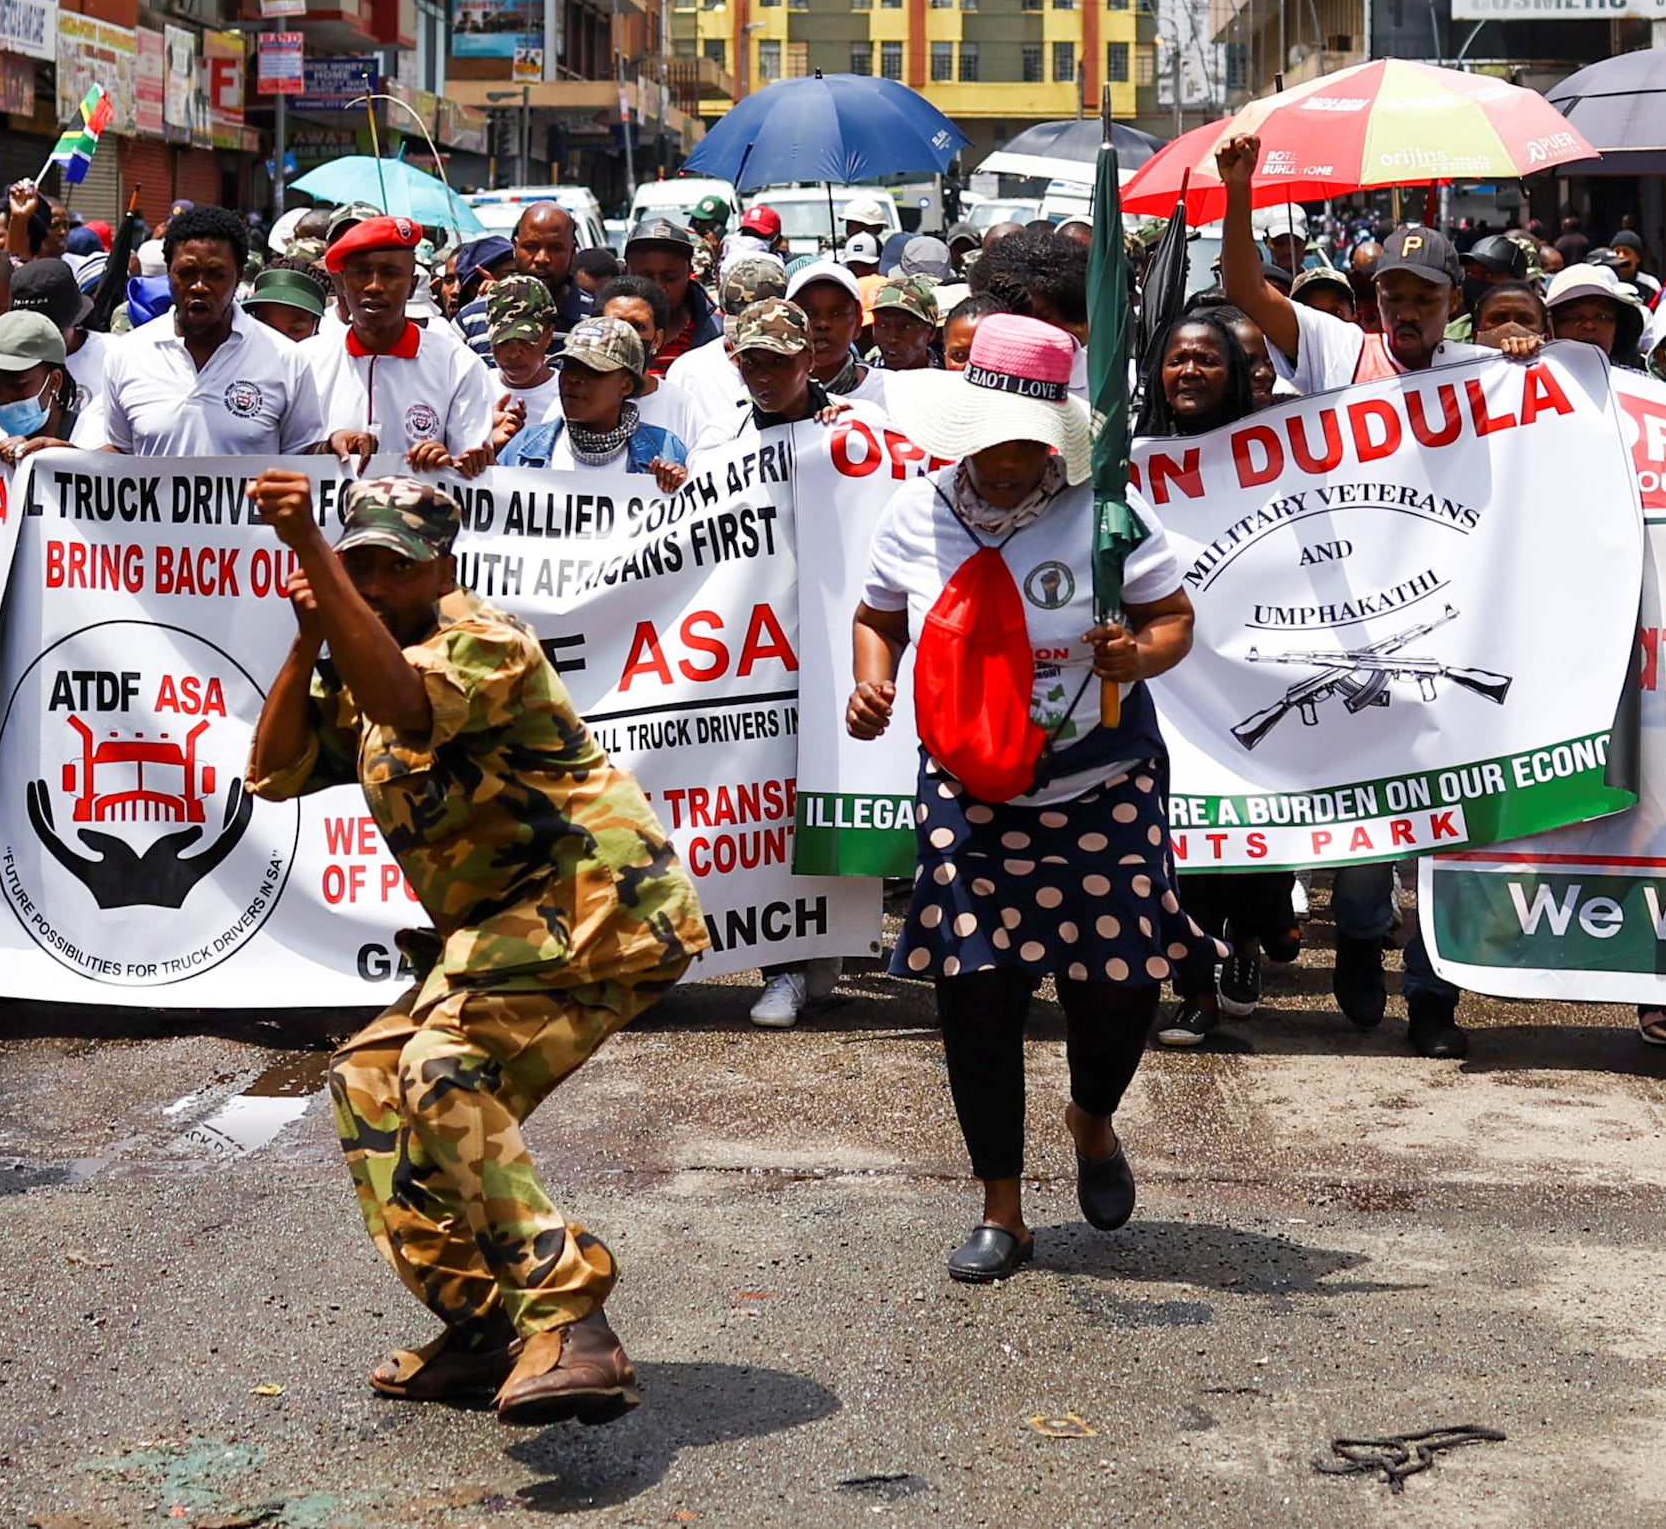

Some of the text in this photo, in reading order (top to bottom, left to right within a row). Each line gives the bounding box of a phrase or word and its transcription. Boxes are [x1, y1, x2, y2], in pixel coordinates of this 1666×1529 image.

[1380, 147, 1448, 168] orijins
[1540, 131, 1577, 151] PUER
[1401, 234, 1423, 258] P
[1017, 376, 1057, 400] LOVE
[1231, 361, 1576, 489] DUDULA
[54, 468, 718, 541] TRUCK ALLIED SOUTH
[46, 506, 778, 598] BRING BACK AFRICANS FIRST
[1183, 482, 1482, 591] MILITARY VETERANS
[1298, 538, 1354, 567] AND
[1253, 567, 1444, 628] UMPHAKATHI
[617, 602, 799, 693] ASA
[49, 670, 228, 718] ATDF ASA
[627, 709, 777, 753] TRUCK DRIVERS
[1218, 761, 1507, 824] A BURDEN ON OUR
[323, 816, 376, 857] WE
[1311, 809, 1463, 856] PARK
[321, 864, 366, 905] OF
[30, 876, 275, 978] POSSIBILITIES FOR TRUCK DRIVERS IN
[1508, 882, 1626, 949] We
